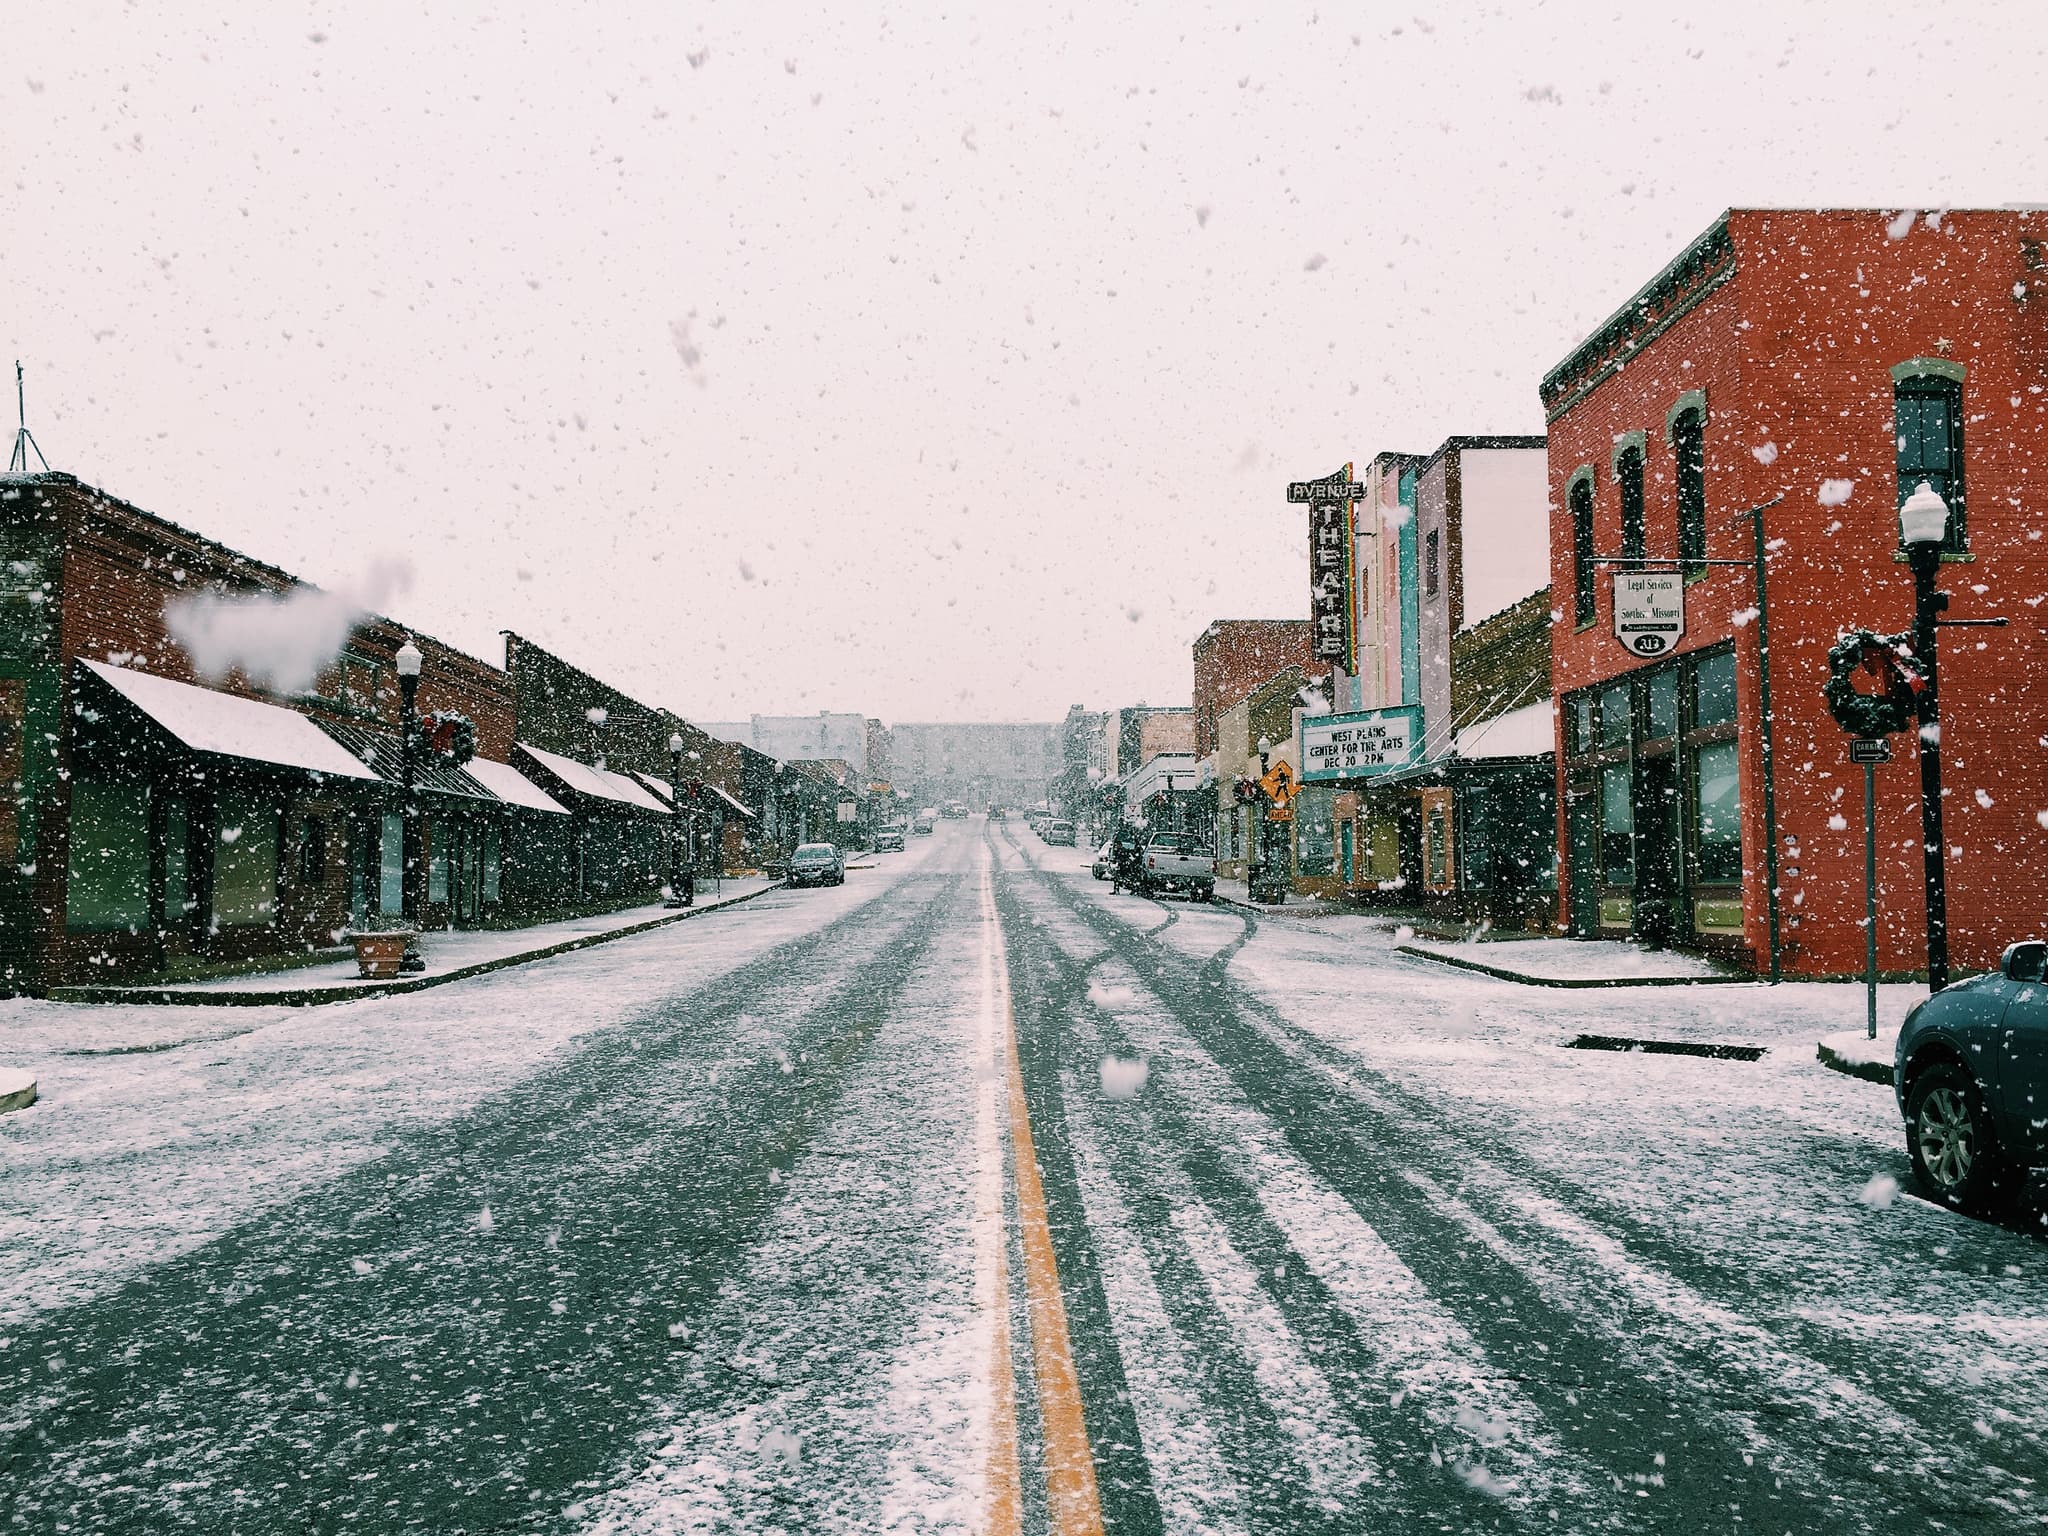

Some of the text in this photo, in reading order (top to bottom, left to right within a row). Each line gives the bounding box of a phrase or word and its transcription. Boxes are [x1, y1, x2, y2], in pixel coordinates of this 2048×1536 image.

[1293, 484, 1362, 498] AVENUE
[1319, 504, 1341, 654] THEATRE
[1627, 578, 1673, 592] Legal Services
[1646, 593, 1654, 604] of
[1621, 607, 1680, 619] Souther Missouri
[1640, 638, 1660, 650] 313
[1331, 726, 1386, 743] WEST PLAINS
[1310, 737, 1403, 757] CENTER FOR THE ARTS
[1856, 743, 1887, 751] PARKING
[1324, 758, 1340, 768] DEC
[1345, 755, 1356, 767] 20
